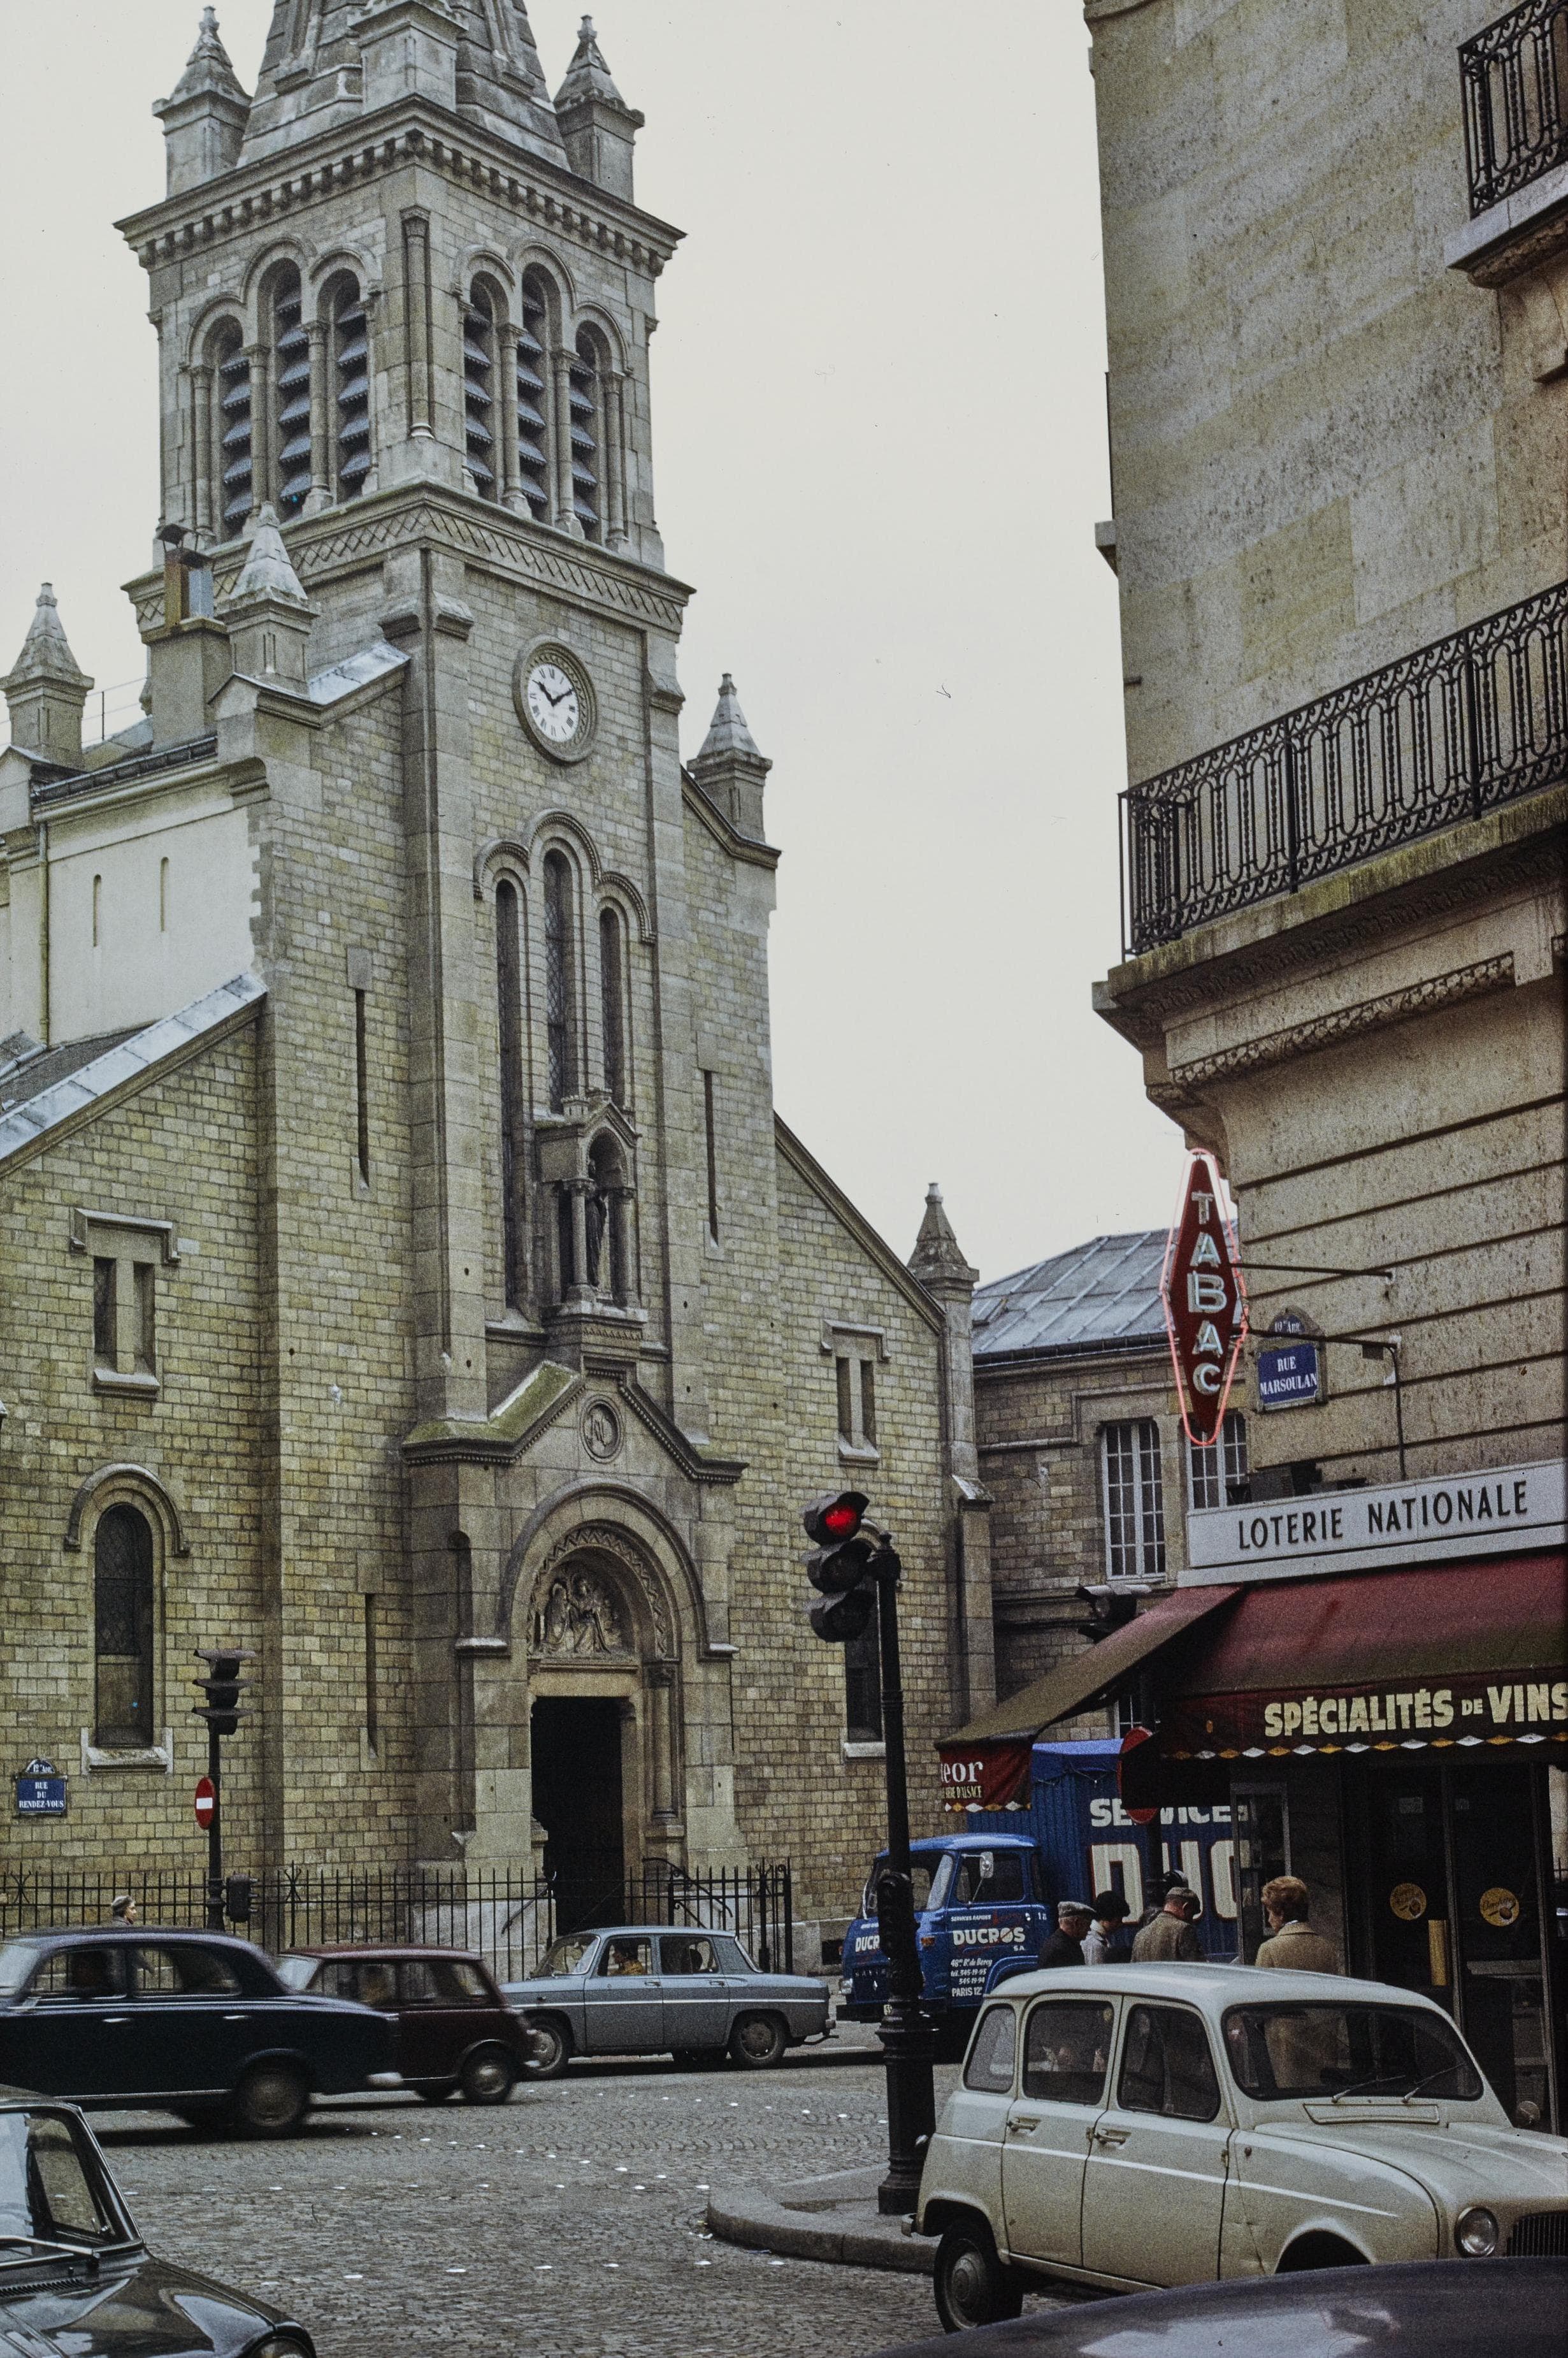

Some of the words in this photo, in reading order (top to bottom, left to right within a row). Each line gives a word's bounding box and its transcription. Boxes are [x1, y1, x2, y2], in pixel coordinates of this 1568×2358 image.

[1187, 1190, 1227, 1395] TABAC
[1277, 1356, 1297, 1372] RUE
[1260, 1372, 1318, 1396] MARSOULAN
[1239, 1508, 1344, 1550] LOTERIE
[1368, 1480, 1528, 1533] NATIONALE
[1264, 1688, 1455, 1737] SPÉCIALITÉS
[1461, 1698, 1483, 1716] DE
[1486, 1682, 1568, 1723] VINS
[19, 1800, 64, 1808] RENDEZ-VOUS
[1090, 1798, 1249, 1827] SEVICE
[855, 1935, 880, 1952] DUCR
[953, 1927, 1026, 1946] DUCROS
[977, 1957, 993, 1967] Bercy
[951, 1987, 974, 1997] PARIS
